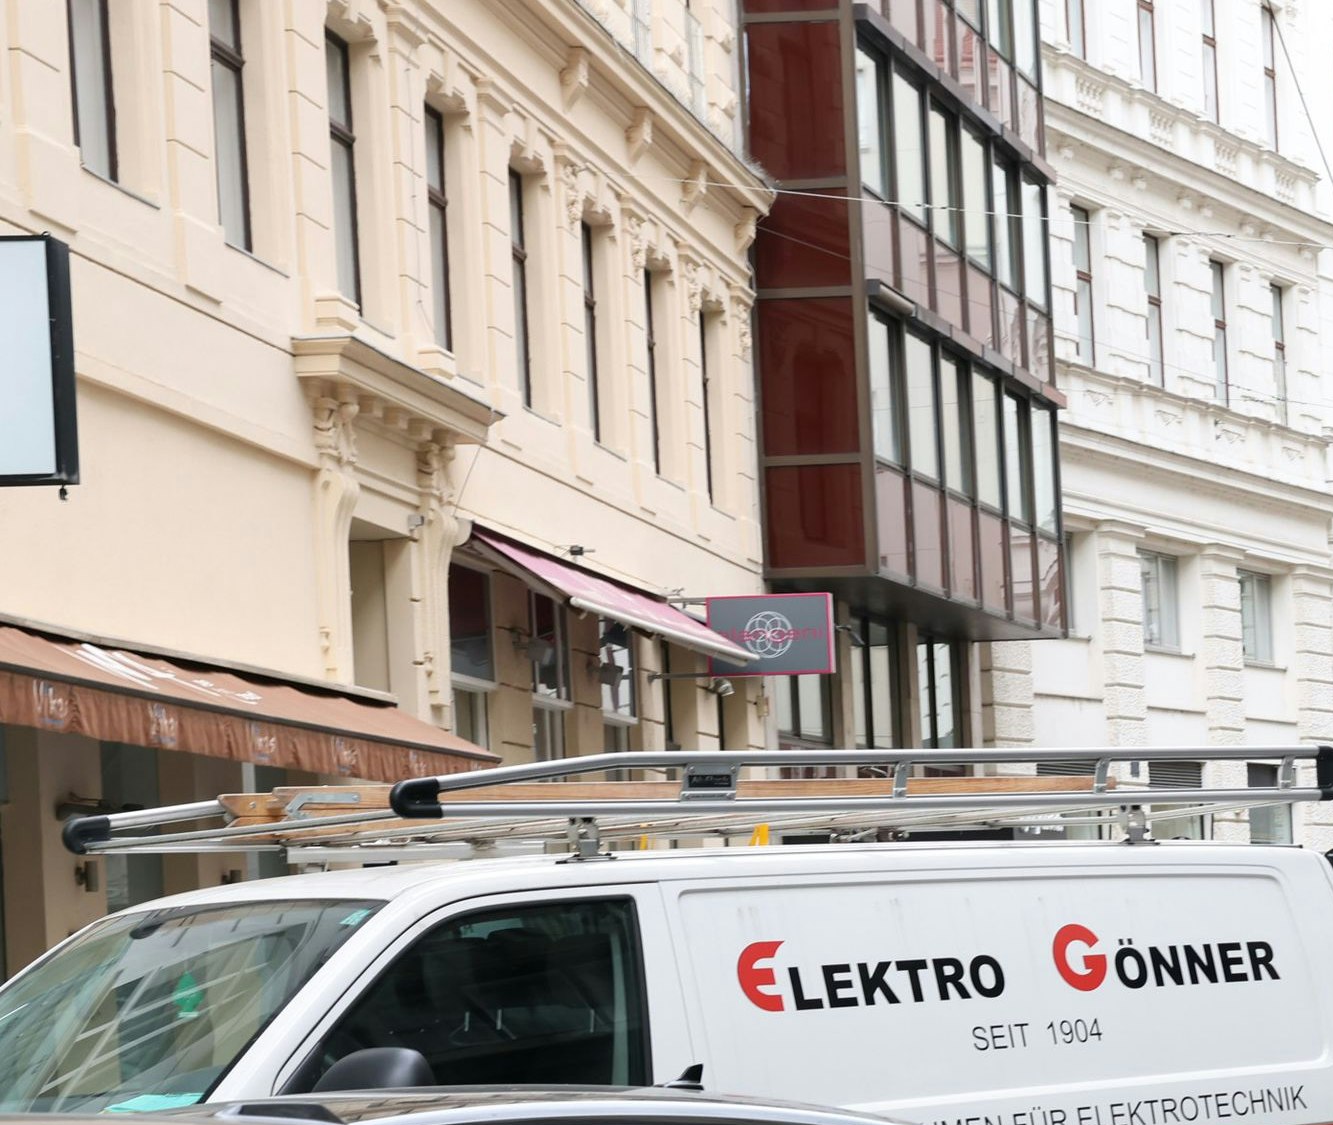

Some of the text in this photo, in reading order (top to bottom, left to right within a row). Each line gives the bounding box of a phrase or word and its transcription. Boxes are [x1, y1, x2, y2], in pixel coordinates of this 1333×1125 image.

[736, 922, 1281, 1012] ELEKTRO GÖNNER
[972, 1017, 1103, 1051] SEIT 1904
